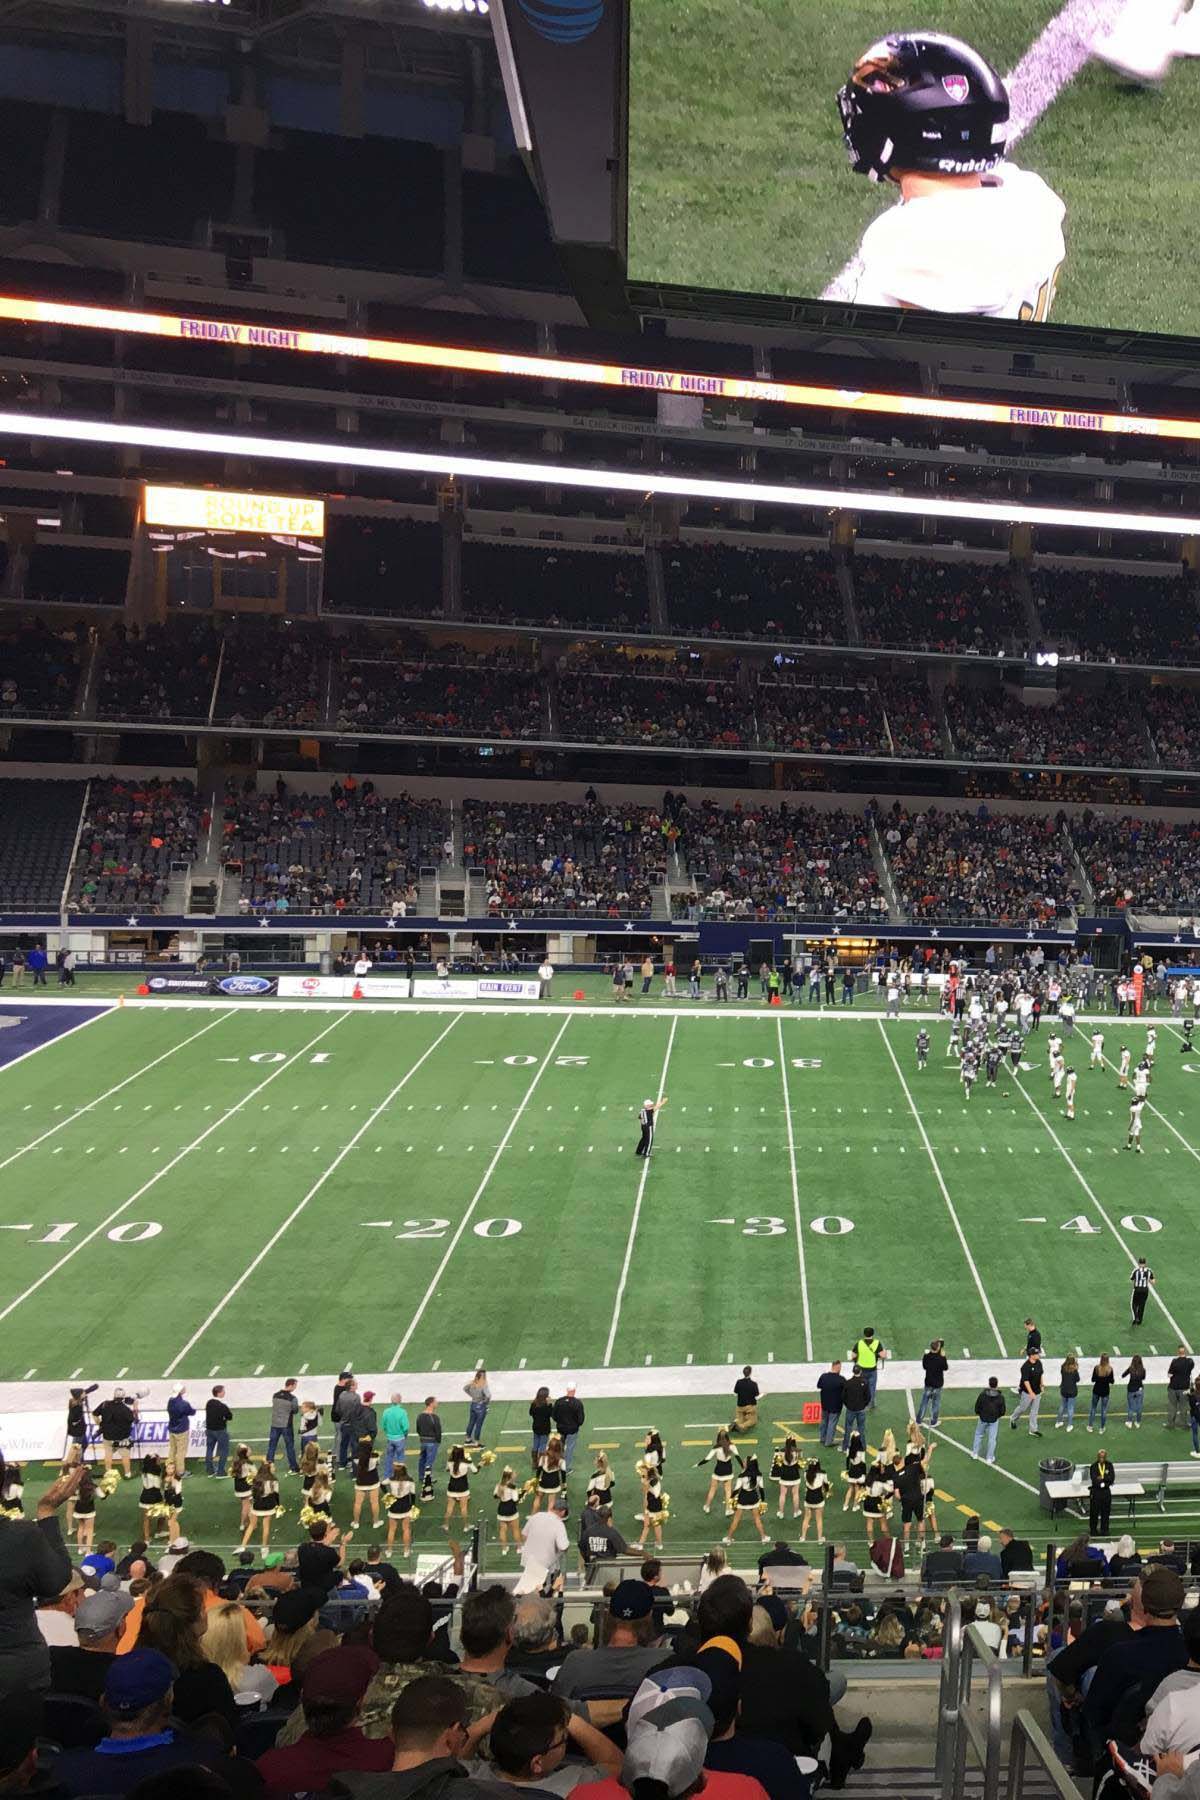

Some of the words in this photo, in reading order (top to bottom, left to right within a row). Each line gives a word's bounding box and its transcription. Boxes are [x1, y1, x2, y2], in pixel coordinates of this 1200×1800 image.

[181, 320, 242, 341] FRIDAY
[249, 327, 302, 348] NIGHT
[621, 370, 675, 388] FRIDAY
[681, 376, 727, 394] NIGHT
[1009, 408, 1057, 426] FRIDAY
[1062, 413, 1105, 430] NIGHT
[287, 501, 315, 517] UP
[206, 511, 268, 530] SOME
[272, 515, 315, 533] TEA
[228, 979, 262, 991] Ford
[302, 979, 318, 988] DQ
[480, 983, 498, 992] MAIN
[500, 984, 523, 993] EVENT
[249, 1052, 336, 1063] 10
[504, 1055, 591, 1066] 20
[742, 1058, 824, 1069] 30
[28, 1221, 163, 1243] 10
[395, 1218, 523, 1239] 20
[743, 1216, 857, 1235] 30
[1060, 1215, 1164, 1234] 40
[132, 1421, 171, 1442] VENT
[588, 1536, 608, 1545] EVENT
